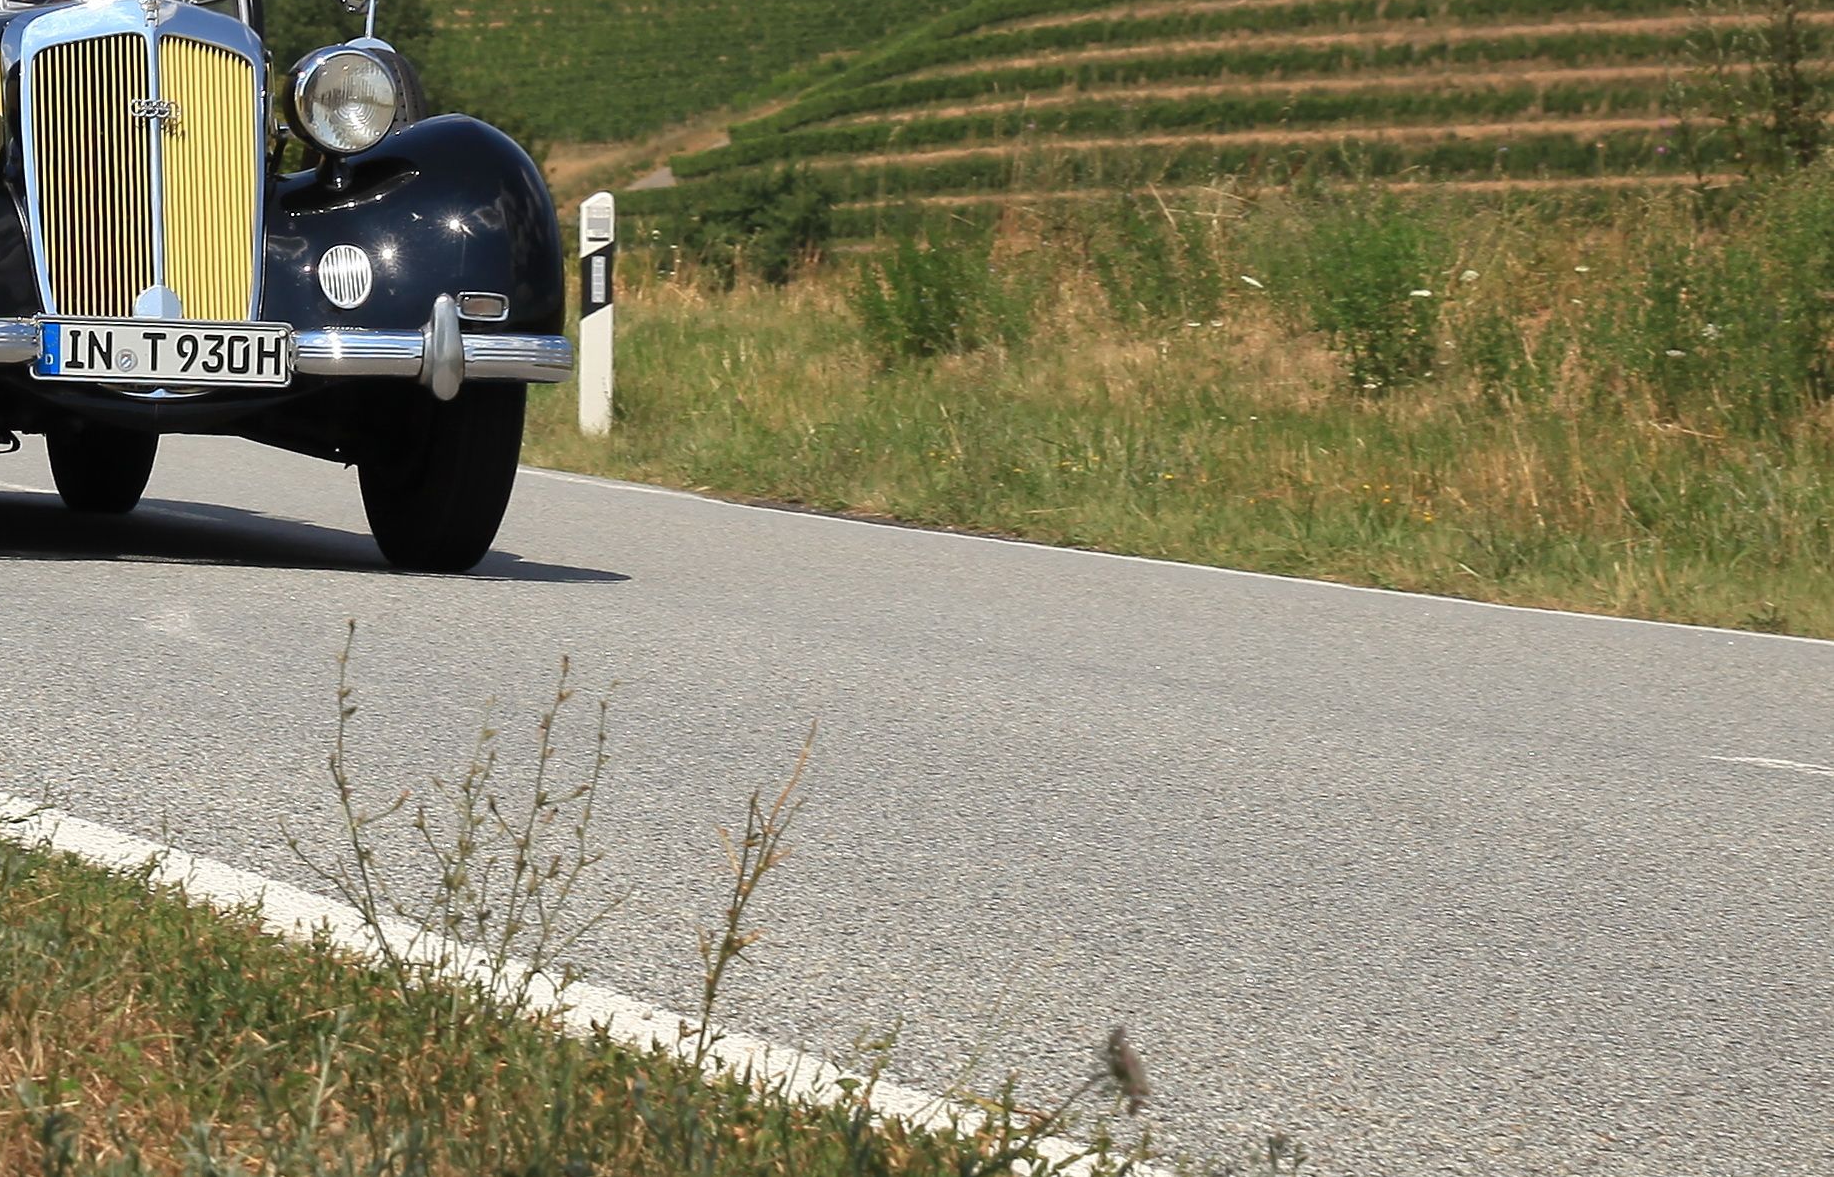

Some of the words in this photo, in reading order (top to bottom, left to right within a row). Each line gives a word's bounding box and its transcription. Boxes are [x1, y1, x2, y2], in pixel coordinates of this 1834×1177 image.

[46, 354, 54, 365] D
[65, 331, 113, 370] IN
[143, 332, 166, 371] T
[176, 334, 281, 375] 930H
